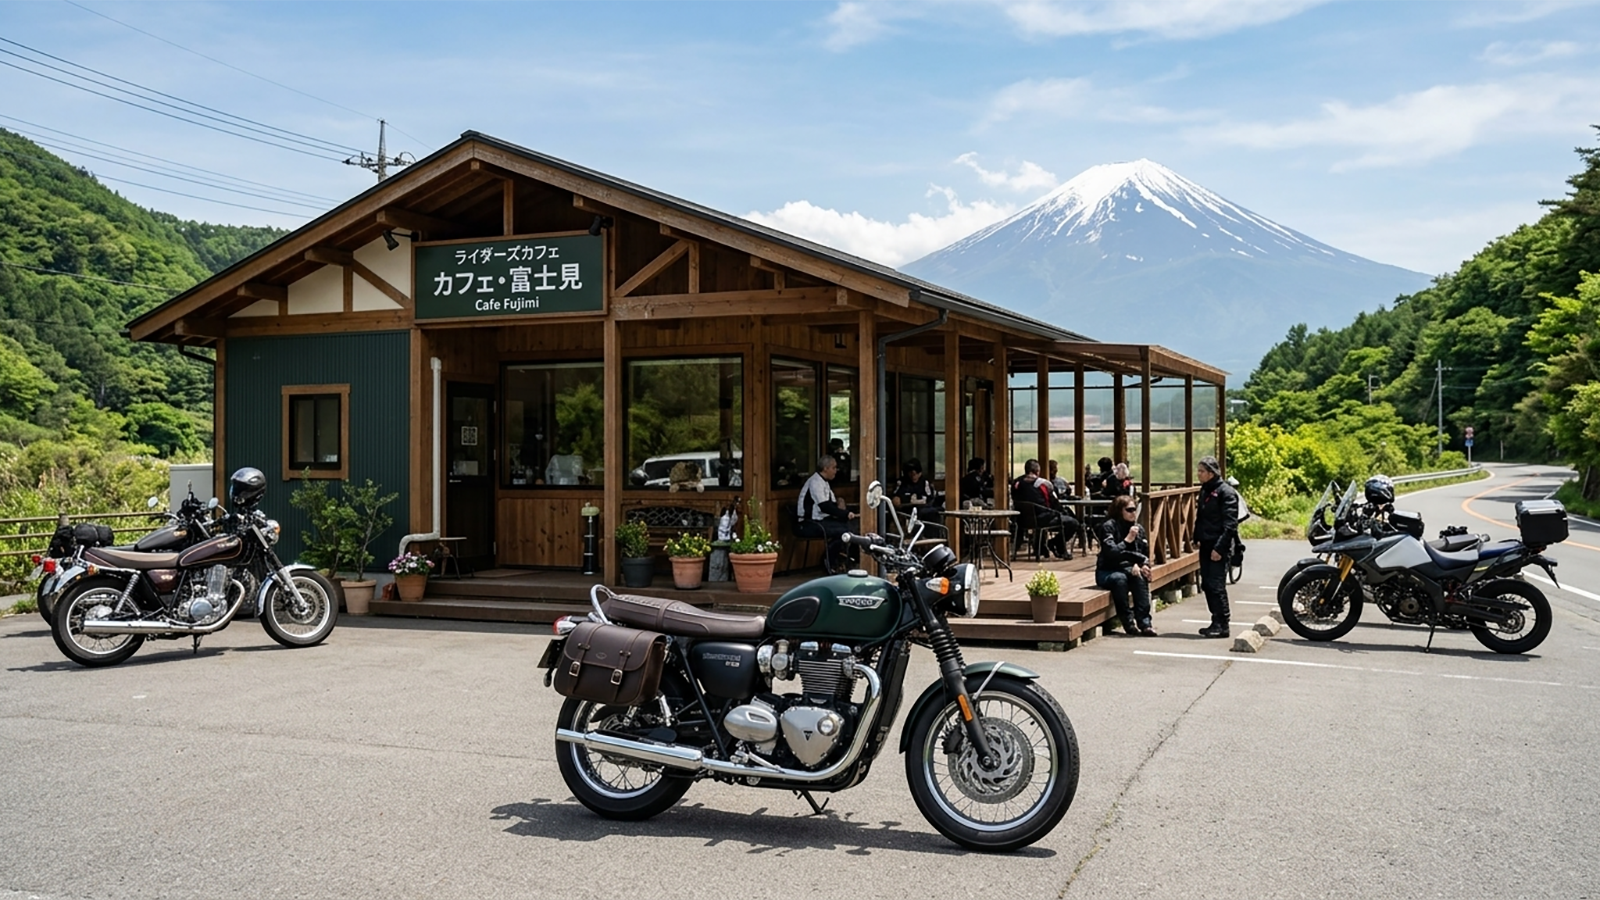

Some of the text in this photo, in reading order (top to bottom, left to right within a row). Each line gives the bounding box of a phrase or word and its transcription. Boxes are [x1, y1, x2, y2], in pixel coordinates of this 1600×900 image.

[455, 245, 560, 265] ライダーズカフェ
[433, 263, 583, 296] カフェ・富士見
[475, 296, 540, 311] Cafe Fujimi
